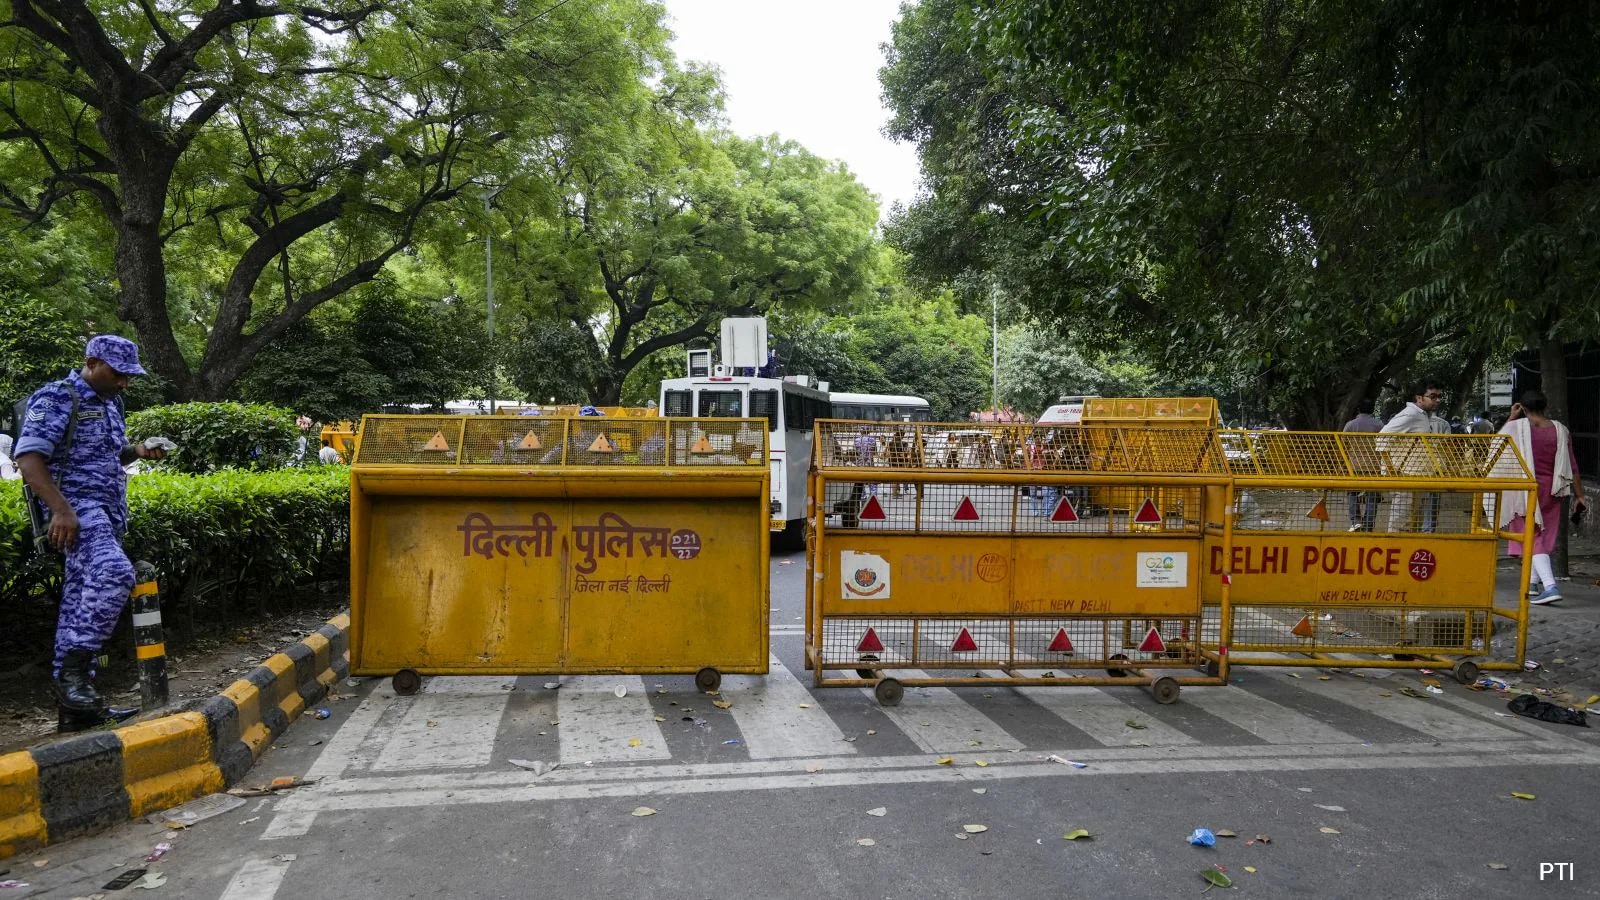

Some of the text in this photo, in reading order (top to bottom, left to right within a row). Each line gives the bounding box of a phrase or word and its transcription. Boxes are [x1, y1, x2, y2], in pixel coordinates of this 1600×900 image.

[457, 512, 671, 574] दिल्ली पुलिस
[678, 550, 692, 560] 22
[1210, 546, 1401, 576] DELHI POLICE
[901, 553, 974, 583] DELHI
[1411, 566, 1428, 579] 48
[574, 574, 672, 593] जिला नई दिल्ली
[1320, 591, 1340, 601] NEW
[1343, 590, 1372, 601] DELHI
[1050, 599, 1075, 611] NEW
[1080, 600, 1111, 612] DELHI
